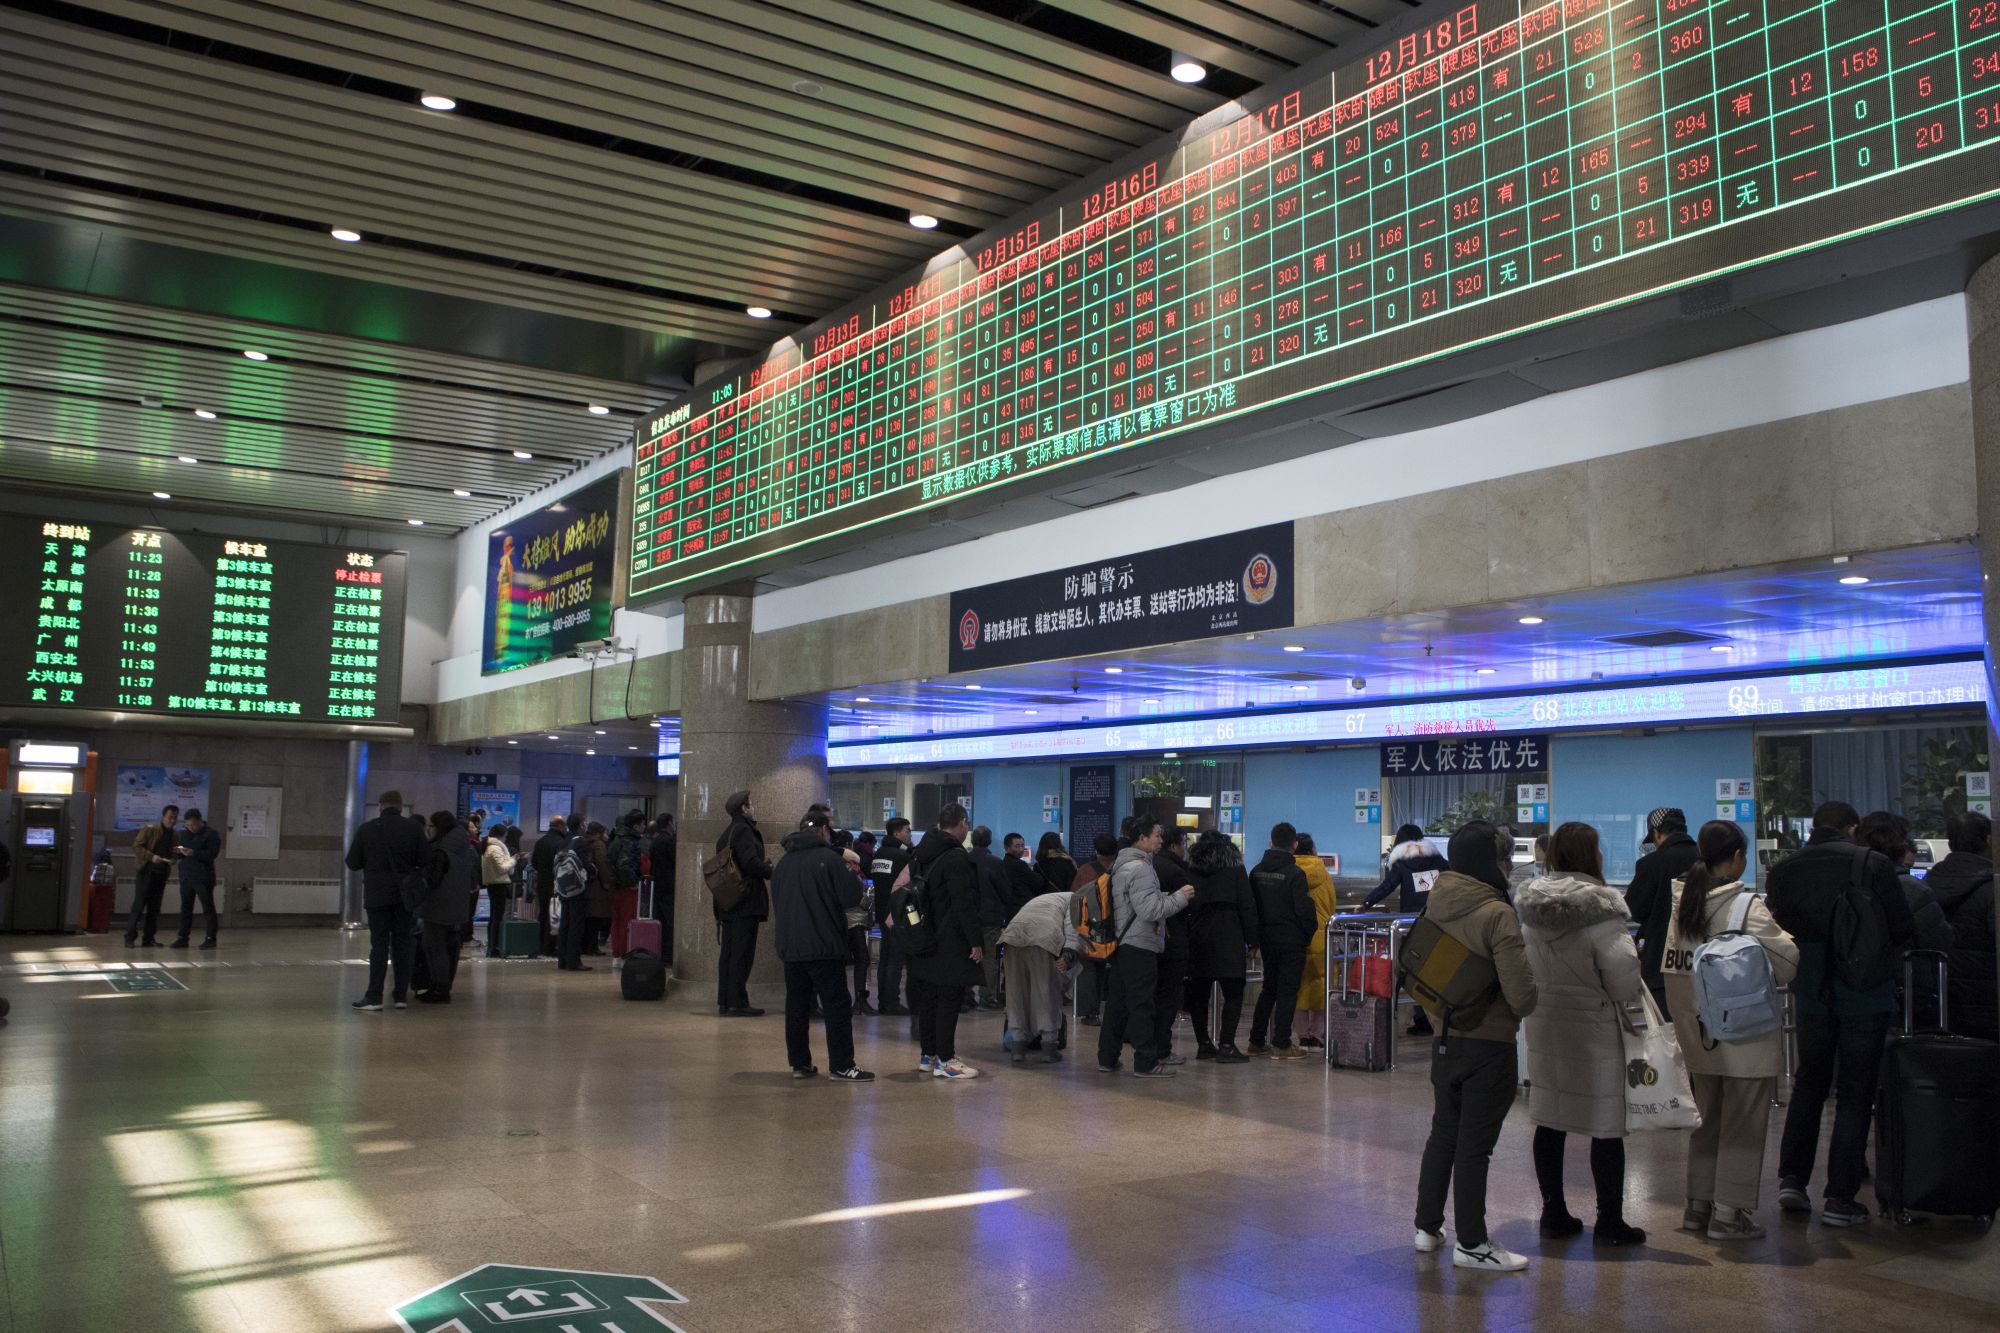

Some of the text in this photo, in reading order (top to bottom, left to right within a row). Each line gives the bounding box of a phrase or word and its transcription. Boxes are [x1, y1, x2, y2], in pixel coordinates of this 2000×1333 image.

[1335, 96, 1365, 123] 软卧
[1369, 81, 1401, 108] 硬卧
[1405, 62, 1439, 90] 软座
[1442, 44, 1477, 74] 硬座
[1481, 24, 1518, 58] 无座
[1346, 135, 1361, 155] 20
[1376, 119, 1398, 141] 524
[1448, 84, 1475, 109] 418
[1494, 68, 1509, 86] 有
[1536, 49, 1553, 72] 21
[1574, 27, 1603, 54] 528
[1385, 159, 1391, 173] 0
[1420, 142, 1429, 159] 2
[1451, 122, 1476, 145] 379
[1586, 73, 1594, 89] 0
[1632, 51, 1642, 70] 2
[1670, 25, 1702, 54] 360
[1348, 242, 1361, 260] 11
[1380, 226, 1402, 248] 166
[1452, 197, 1479, 220] 312
[1497, 182, 1513, 204] 有
[1542, 167, 1560, 189] 12
[1581, 147, 1609, 174] 165
[1675, 112, 1707, 138] 294
[1732, 92, 1753, 114] 有
[1789, 71, 1813, 96] 12
[1842, 47, 1879, 77] 158
[814, 316, 859, 354] 12月13日
[889, 272, 941, 318] 12月14日
[977, 221, 1040, 273] 12月15日
[1083, 161, 1156, 220] 12月16日
[1213, 91, 1300, 158] 12月17日
[1366, 3, 1477, 84] 12月18日
[1387, 267, 1394, 281] 0
[1424, 251, 1433, 268] 5
[1455, 236, 1480, 258] 349
[1591, 194, 1599, 210] 0
[1638, 176, 1648, 195] 5
[1677, 154, 1710, 181] 339
[1856, 100, 1866, 119] 0
[1919, 76, 1932, 97] 5
[1388, 304, 1395, 318] 0
[1421, 290, 1437, 308] 21
[1456, 275, 1482, 296] 320
[1500, 260, 1517, 284] 无
[1593, 235, 1601, 252] 0
[1636, 218, 1655, 239] 21
[1680, 198, 1712, 224] 319
[1737, 181, 1758, 208] 无
[1859, 147, 1869, 166] 0
[1916, 122, 1944, 149] 20
[713, 384, 732, 404] 11:03
[922, 383, 1236, 499] 显示数据仅供参考，实际票额信息请以售票窗口为准
[43, 523, 373, 567] 终到站 开点 候车室 状态
[128, 569, 161, 581] 11:28
[216, 576, 271, 591] 第3候车室
[335, 587, 382, 600] 正在检票
[130, 552, 162, 563] 11:23
[217, 558, 272, 574] 第3候车室
[336, 569, 382, 584] 停止检票
[1064, 562, 1135, 602] 防骗警示
[41, 578, 381, 617] 太原南 11:33 第8候车室 正在检票
[527, 596, 542, 620] 139
[544, 588, 566, 614] 1013
[567, 577, 592, 606] 9955
[38, 615, 378, 650] 贵阳北 11:43 第9候车室 正在检票
[125, 605, 158, 616] 11:36
[213, 610, 269, 625] 第3候车室
[333, 621, 380, 634] 正在检票
[36, 651, 376, 684] 西安北 11:53 第7候车室 正在候车
[122, 641, 156, 652] 11:49
[211, 645, 267, 660] 第4候车室
[330, 654, 378, 667] 正在检票
[27, 669, 376, 701] 大兴机场 11:57 第10候车室 正在候车
[119, 694, 152, 705] 11:58
[328, 705, 375, 717] 正在候车
[860, 749, 870, 761] 63
[931, 744, 943, 757] 64
[1106, 730, 1121, 747] 65
[1217, 722, 1234, 740] 66
[1346, 713, 1366, 733] 67
[1532, 699, 1558, 721] 68
[1562, 690, 1686, 718] 北京西站欢迎您
[1728, 684, 1759, 708] 69
[1786, 667, 1908, 695] 售票/改签窗口
[1386, 739, 1540, 773] 军人依法优先
